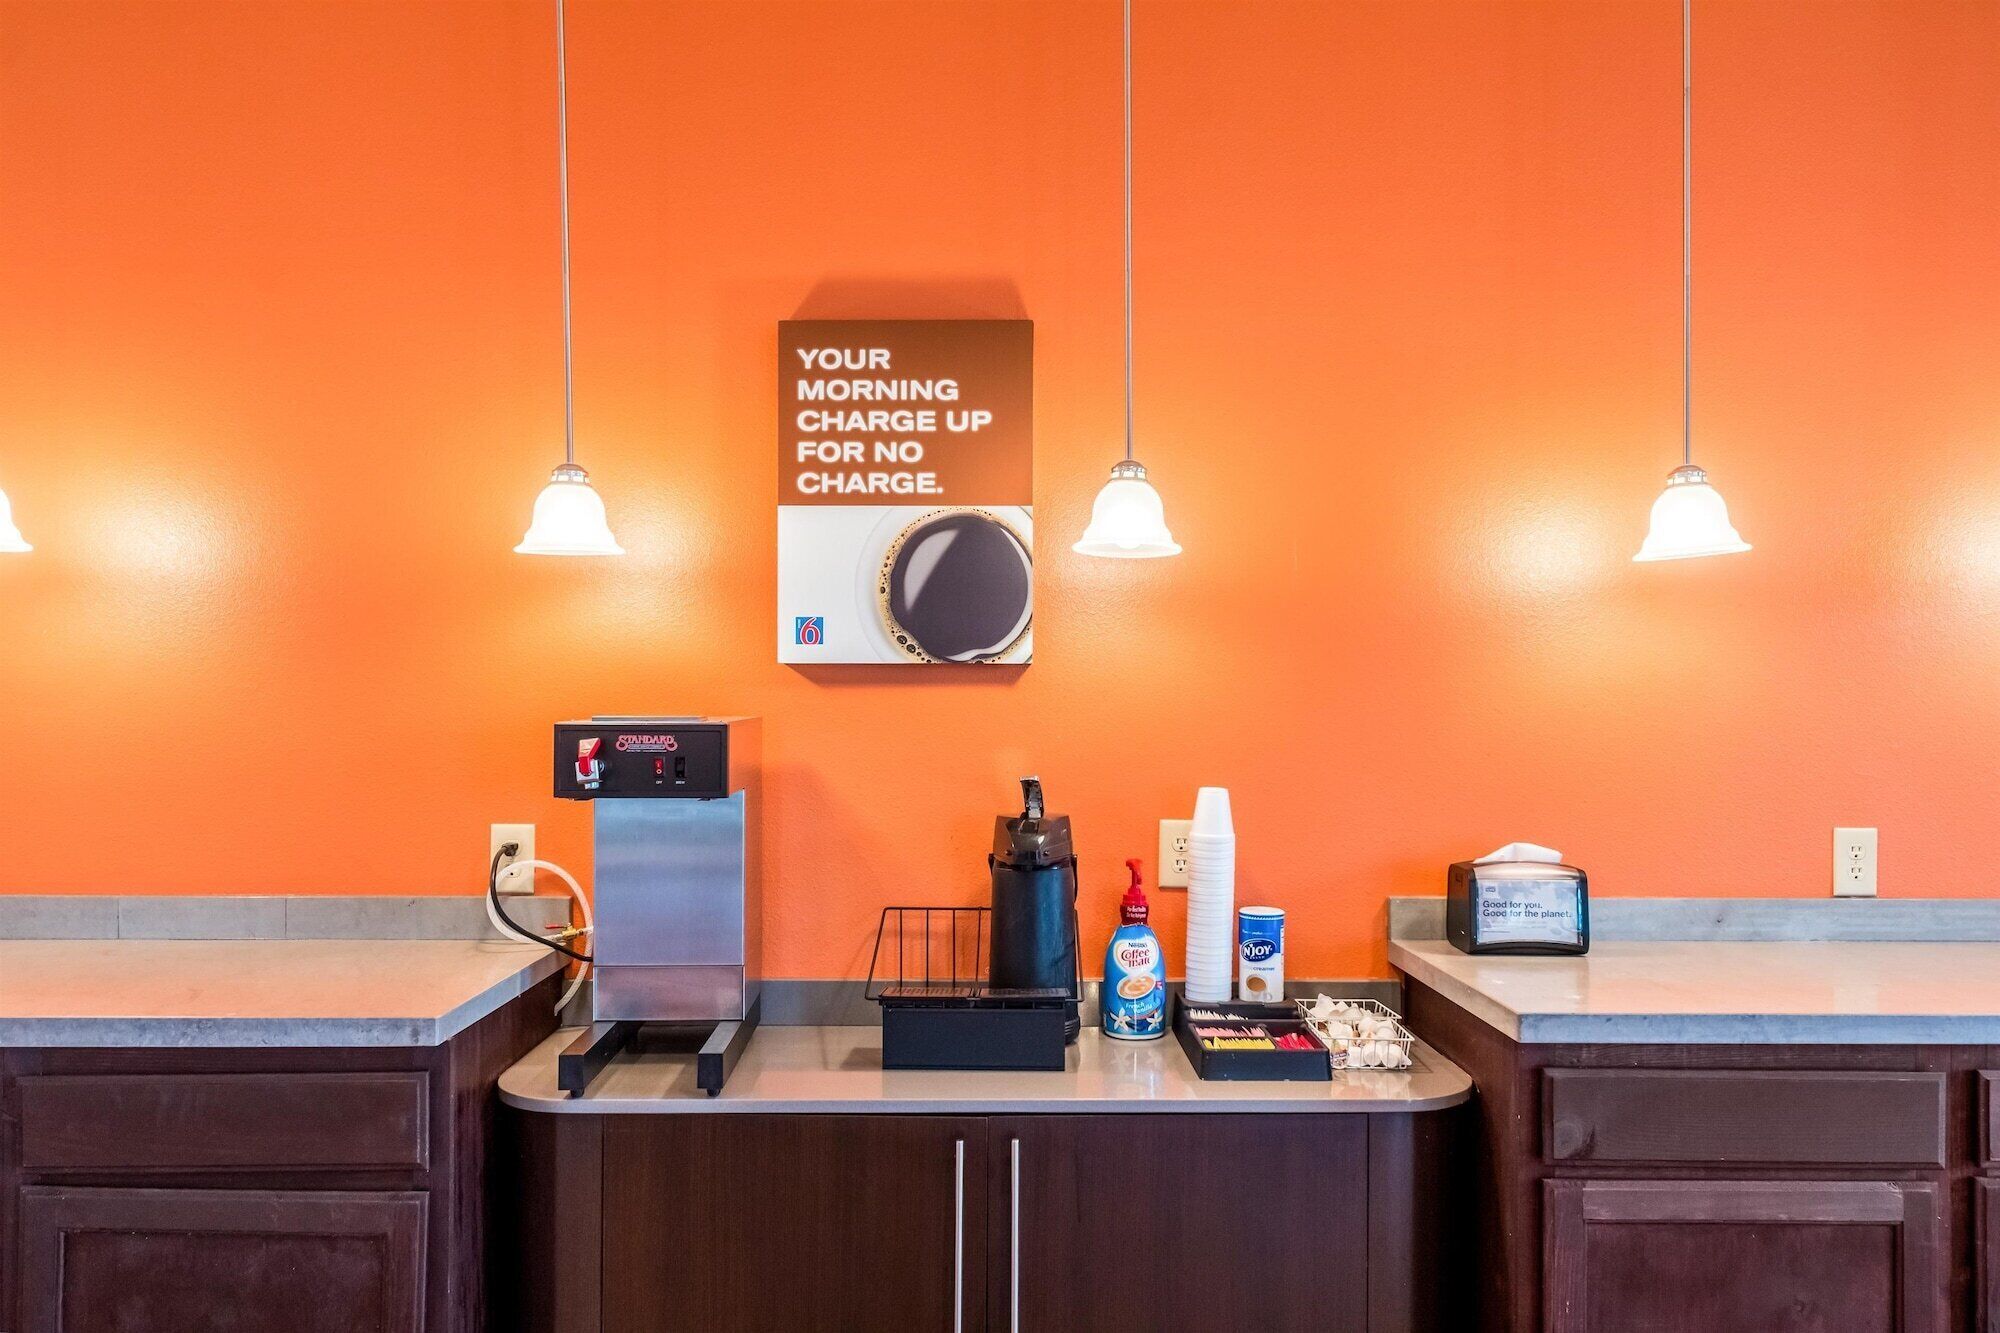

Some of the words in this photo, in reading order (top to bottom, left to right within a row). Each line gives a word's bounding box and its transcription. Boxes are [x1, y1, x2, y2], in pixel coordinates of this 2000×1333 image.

[797, 348, 891, 369] YOUR
[797, 379, 959, 401] MORNING
[797, 410, 937, 432] CHARGE
[946, 410, 992, 432] UP
[797, 441, 864, 463] FOR
[874, 441, 923, 463] NO
[797, 472, 944, 494] CHARGE.
[800, 617, 821, 645] 6
[616, 735, 678, 751] STANDARD
[1483, 901, 1507, 909] Good
[1509, 900, 1521, 909] for
[1483, 909, 1507, 917] Good
[1509, 909, 1521, 917] for
[1524, 909, 1539, 918] the
[1541, 909, 1572, 919] planet.
[1121, 948, 1150, 962] Coffee
